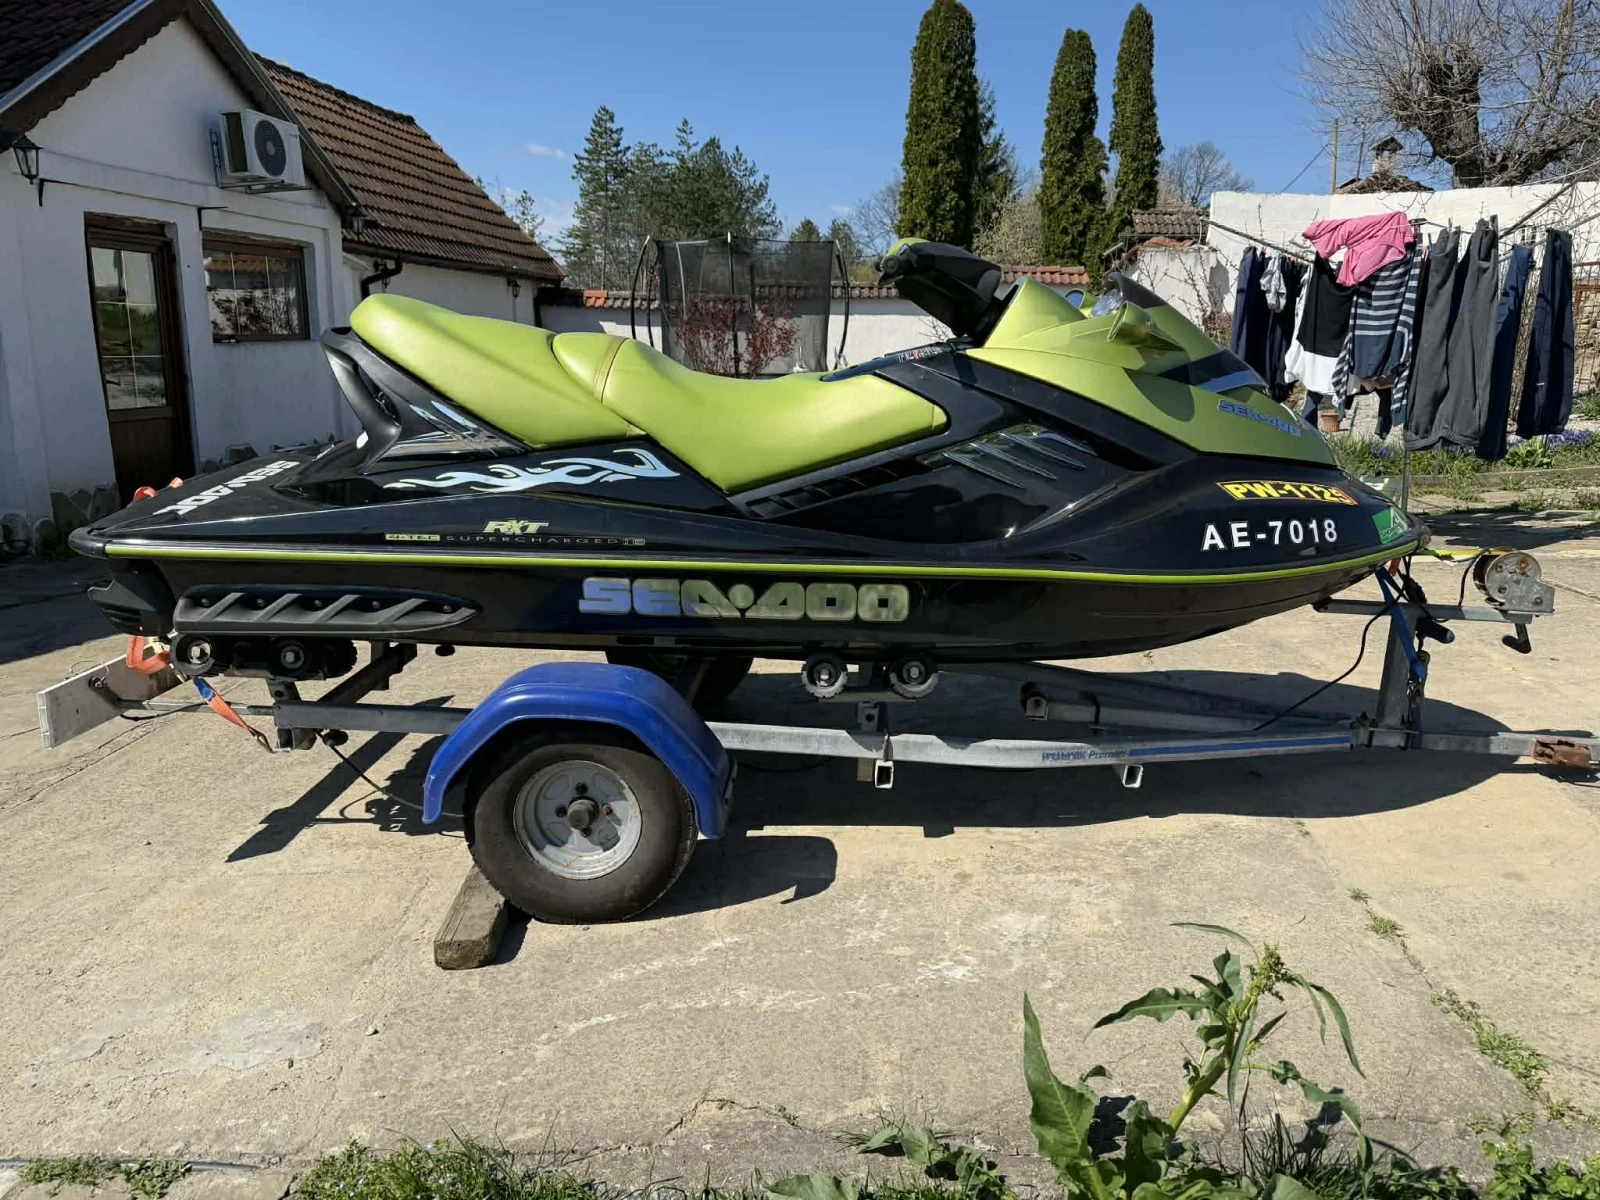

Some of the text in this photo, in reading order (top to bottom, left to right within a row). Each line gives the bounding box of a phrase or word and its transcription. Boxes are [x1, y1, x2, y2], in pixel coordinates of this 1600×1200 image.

[483, 518, 549, 535] RXT
[1200, 518, 1338, 552] AE-7018
[445, 535, 619, 545] SUPERCHARGED
